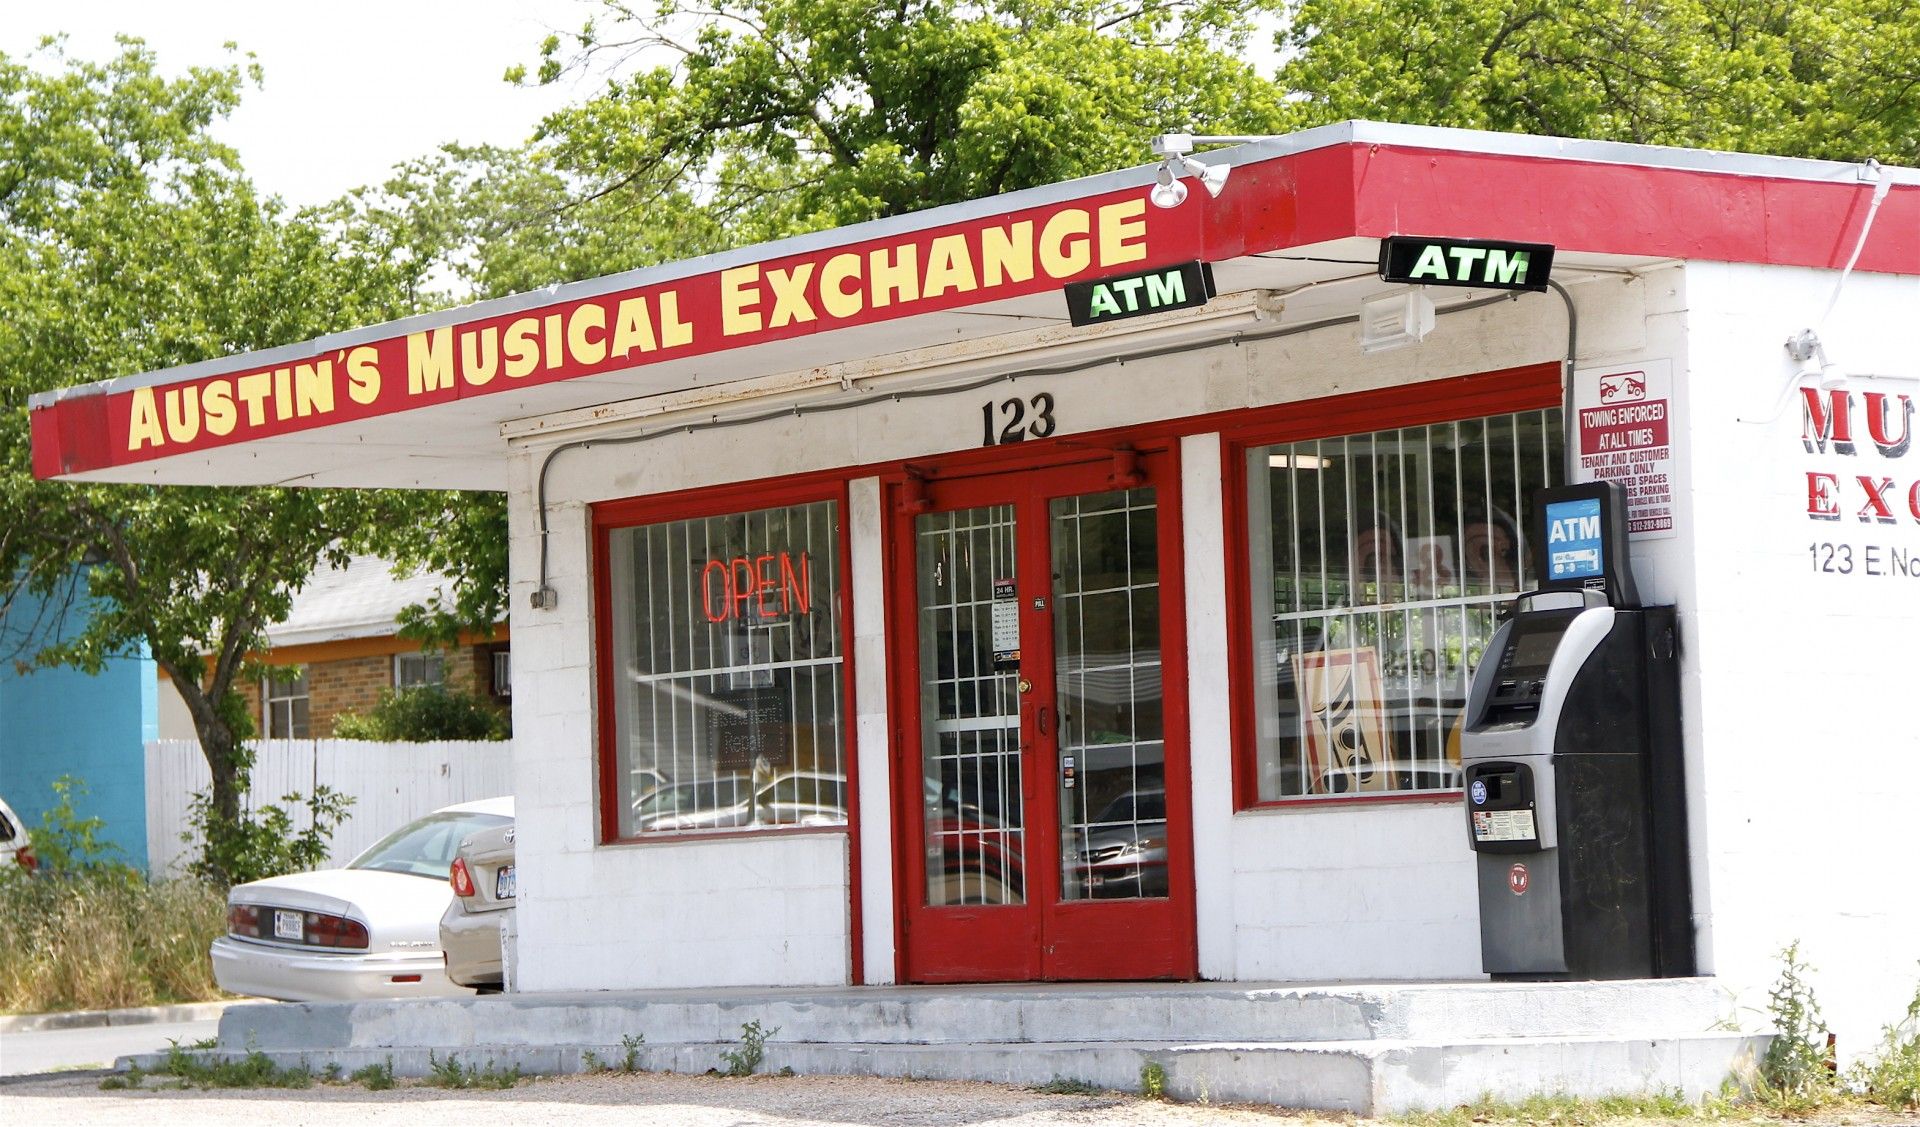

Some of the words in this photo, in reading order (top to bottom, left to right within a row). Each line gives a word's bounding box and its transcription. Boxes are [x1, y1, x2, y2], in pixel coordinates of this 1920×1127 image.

[1408, 244, 1531, 285] ATM
[1089, 269, 1187, 319] ATM
[127, 346, 381, 451] AUSTIN'S
[406, 290, 693, 396] MUSICAL
[721, 197, 1147, 337] EXCHANGE
[982, 392, 1055, 446] 123
[1583, 409, 1617, 429] TOWING
[1618, 403, 1665, 424] ENFORCED
[1599, 433, 1610, 450] AT
[1611, 432, 1627, 448] ALL
[1628, 428, 1654, 446] TIMES
[1581, 454, 1609, 469] TENANT
[1611, 453, 1627, 466] AND
[1629, 448, 1670, 463] CUSTOMER
[1594, 464, 1631, 479] PARKING
[1634, 462, 1655, 475] ONLY
[1638, 474, 1667, 485] SPACES
[1639, 484, 1670, 496] PARKING
[1549, 515, 1601, 544] ATM
[1809, 542, 1853, 575] 123
[702, 551, 809, 623] OPEN
